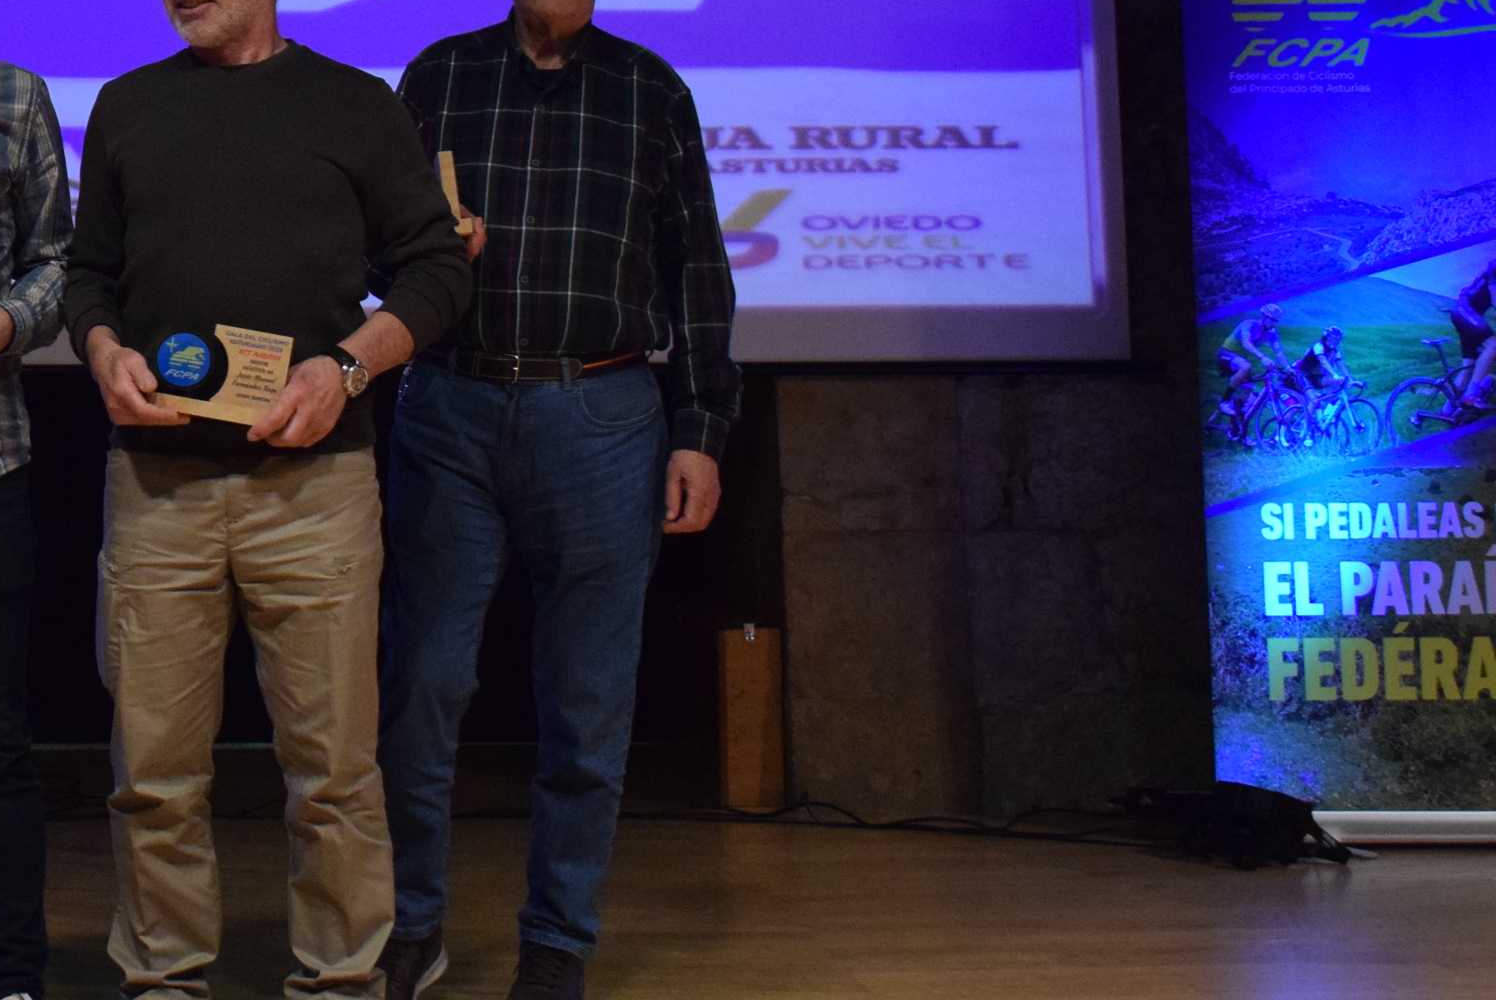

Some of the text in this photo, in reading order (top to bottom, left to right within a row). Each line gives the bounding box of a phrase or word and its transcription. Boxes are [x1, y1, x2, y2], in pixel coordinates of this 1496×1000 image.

[1231, 37, 1370, 68] FCPA
[1249, 83, 1308, 95] Principado
[1326, 82, 1371, 94] Asturias
[789, 125, 1020, 151] RURAL
[801, 214, 983, 231] OVIEDO
[801, 234, 972, 250] VIVE EL
[802, 253, 1032, 271] DEPORTE
[164, 368, 201, 380] FCPA
[1261, 501, 1486, 541] SI PEDALEAS
[1262, 560, 1325, 618] EL
[1266, 622, 1496, 701] FEDÉRA
